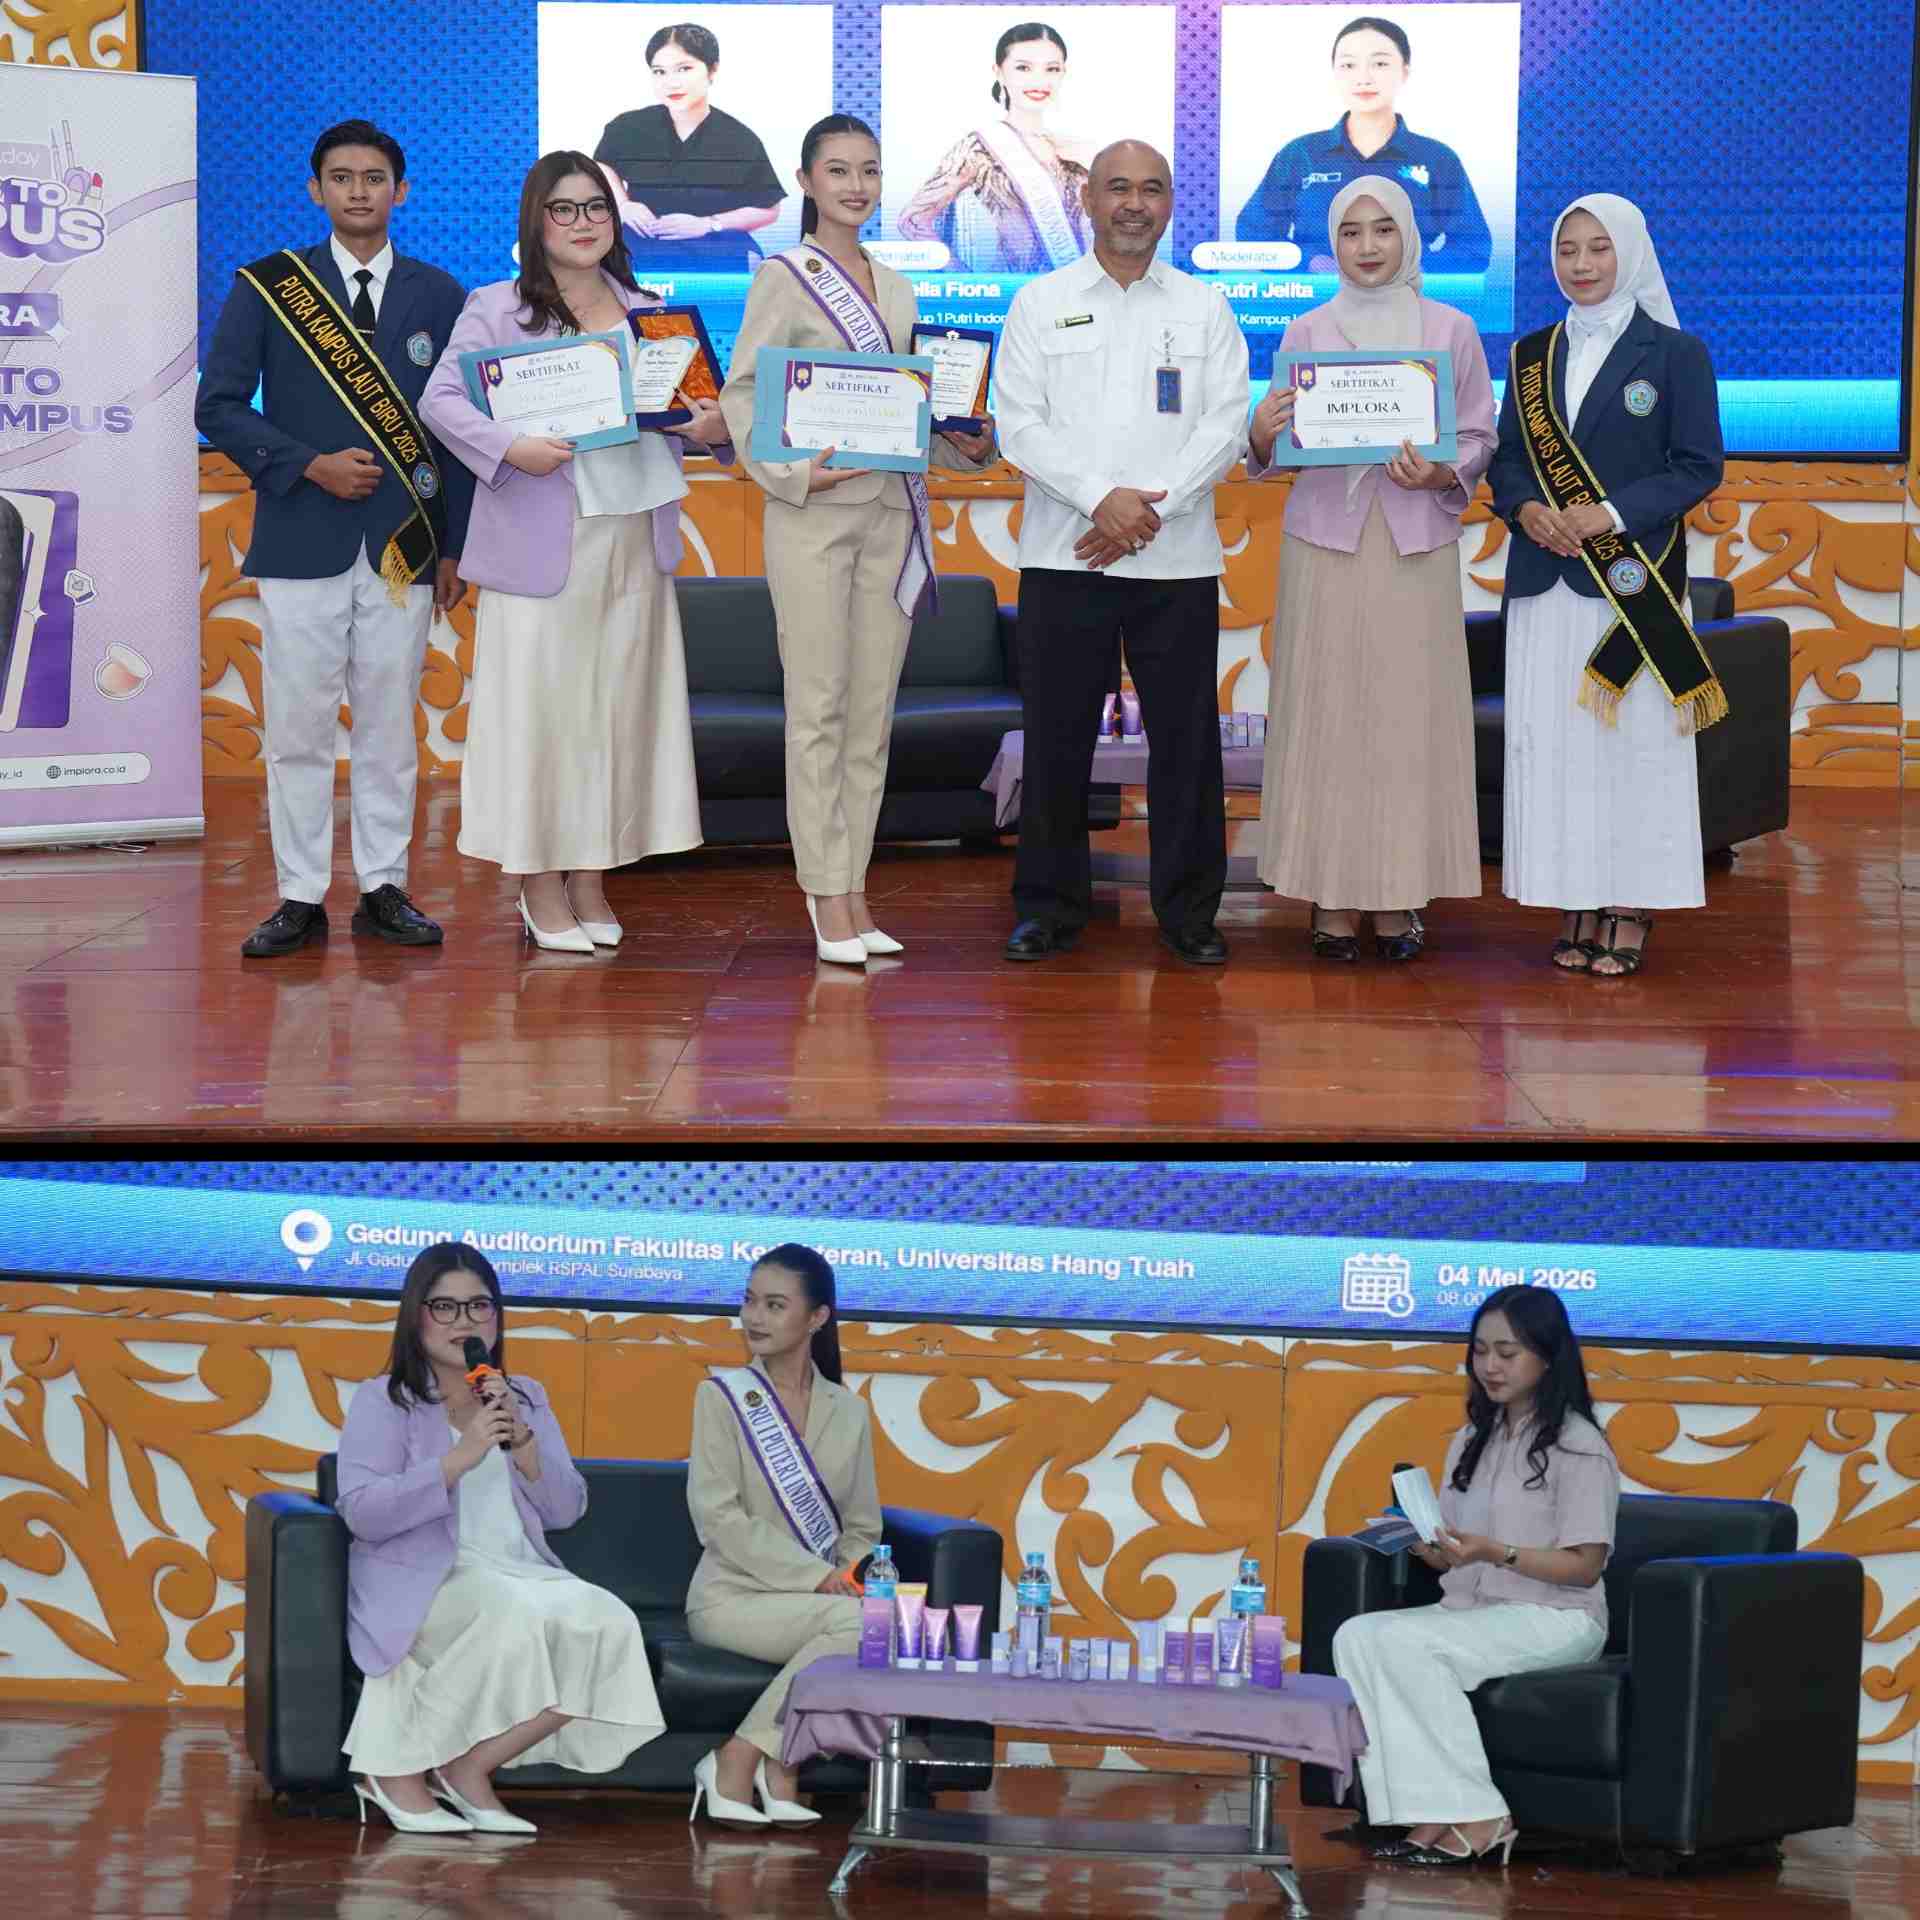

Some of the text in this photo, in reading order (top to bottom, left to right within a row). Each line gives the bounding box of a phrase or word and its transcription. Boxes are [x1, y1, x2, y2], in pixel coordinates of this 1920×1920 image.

[11, 179, 67, 206] TO
[0, 203, 103, 251] US
[946, 281, 1000, 298] Fiona
[1211, 282, 1313, 298] Putri Jelita
[812, 270, 838, 290] RU
[832, 292, 875, 342] PUTERI
[945, 312, 972, 324] Putri
[1239, 313, 1290, 326] Kampus
[0, 366, 61, 396] TO
[274, 275, 421, 463] PUTRA KAMPUS LAUT BIRU 2025
[515, 361, 582, 380] SERTIFIKAT
[1520, 360, 1542, 404] PUTRI
[824, 381, 891, 395] SERTIFIKAT
[1330, 378, 1397, 389] SERTIFIKAT
[0, 403, 135, 433] MPUS
[1327, 400, 1401, 414] IMPLORA
[1527, 402, 1561, 459] KAMPUS
[1546, 454, 1584, 495] LAUT
[1588, 532, 1624, 560] 025
[64, 765, 126, 777] implora.co.id
[463, 1229, 605, 1255] Auditorium
[614, 1236, 724, 1260] Fakultas
[897, 1247, 1044, 1273] Universitas
[1051, 1254, 1122, 1280] Hang
[1128, 1256, 1195, 1279] Tuah
[549, 1261, 600, 1279] RSPAL
[608, 1262, 683, 1281] Surabaya
[1438, 1264, 1597, 1290] 04 Mei 2026
[746, 1404, 775, 1427] RU
[760, 1431, 800, 1483] PUTERI
[784, 1477, 834, 1548] INDONESIA
